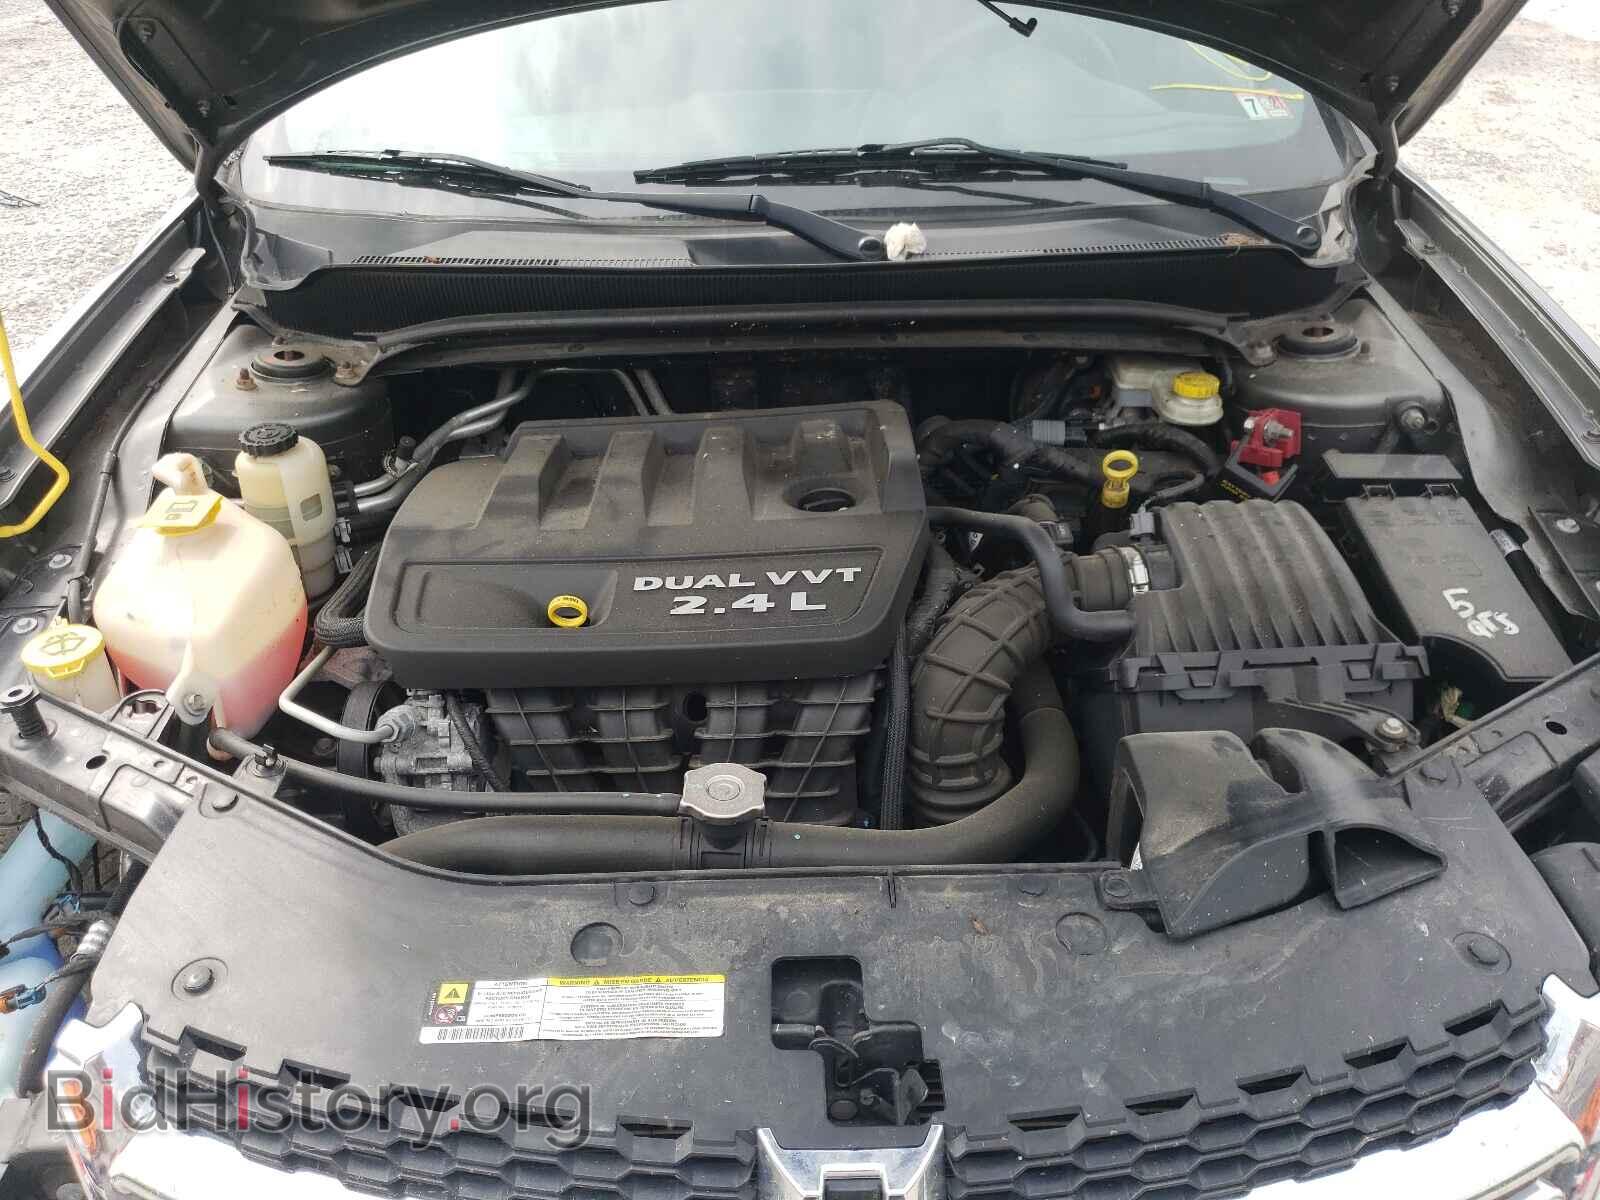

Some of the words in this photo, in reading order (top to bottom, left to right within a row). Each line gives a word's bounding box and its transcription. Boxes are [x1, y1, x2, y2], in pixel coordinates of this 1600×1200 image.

[1243, 98, 1259, 116] 7
[633, 573, 756, 592] DUAL
[766, 567, 862, 586] VVT
